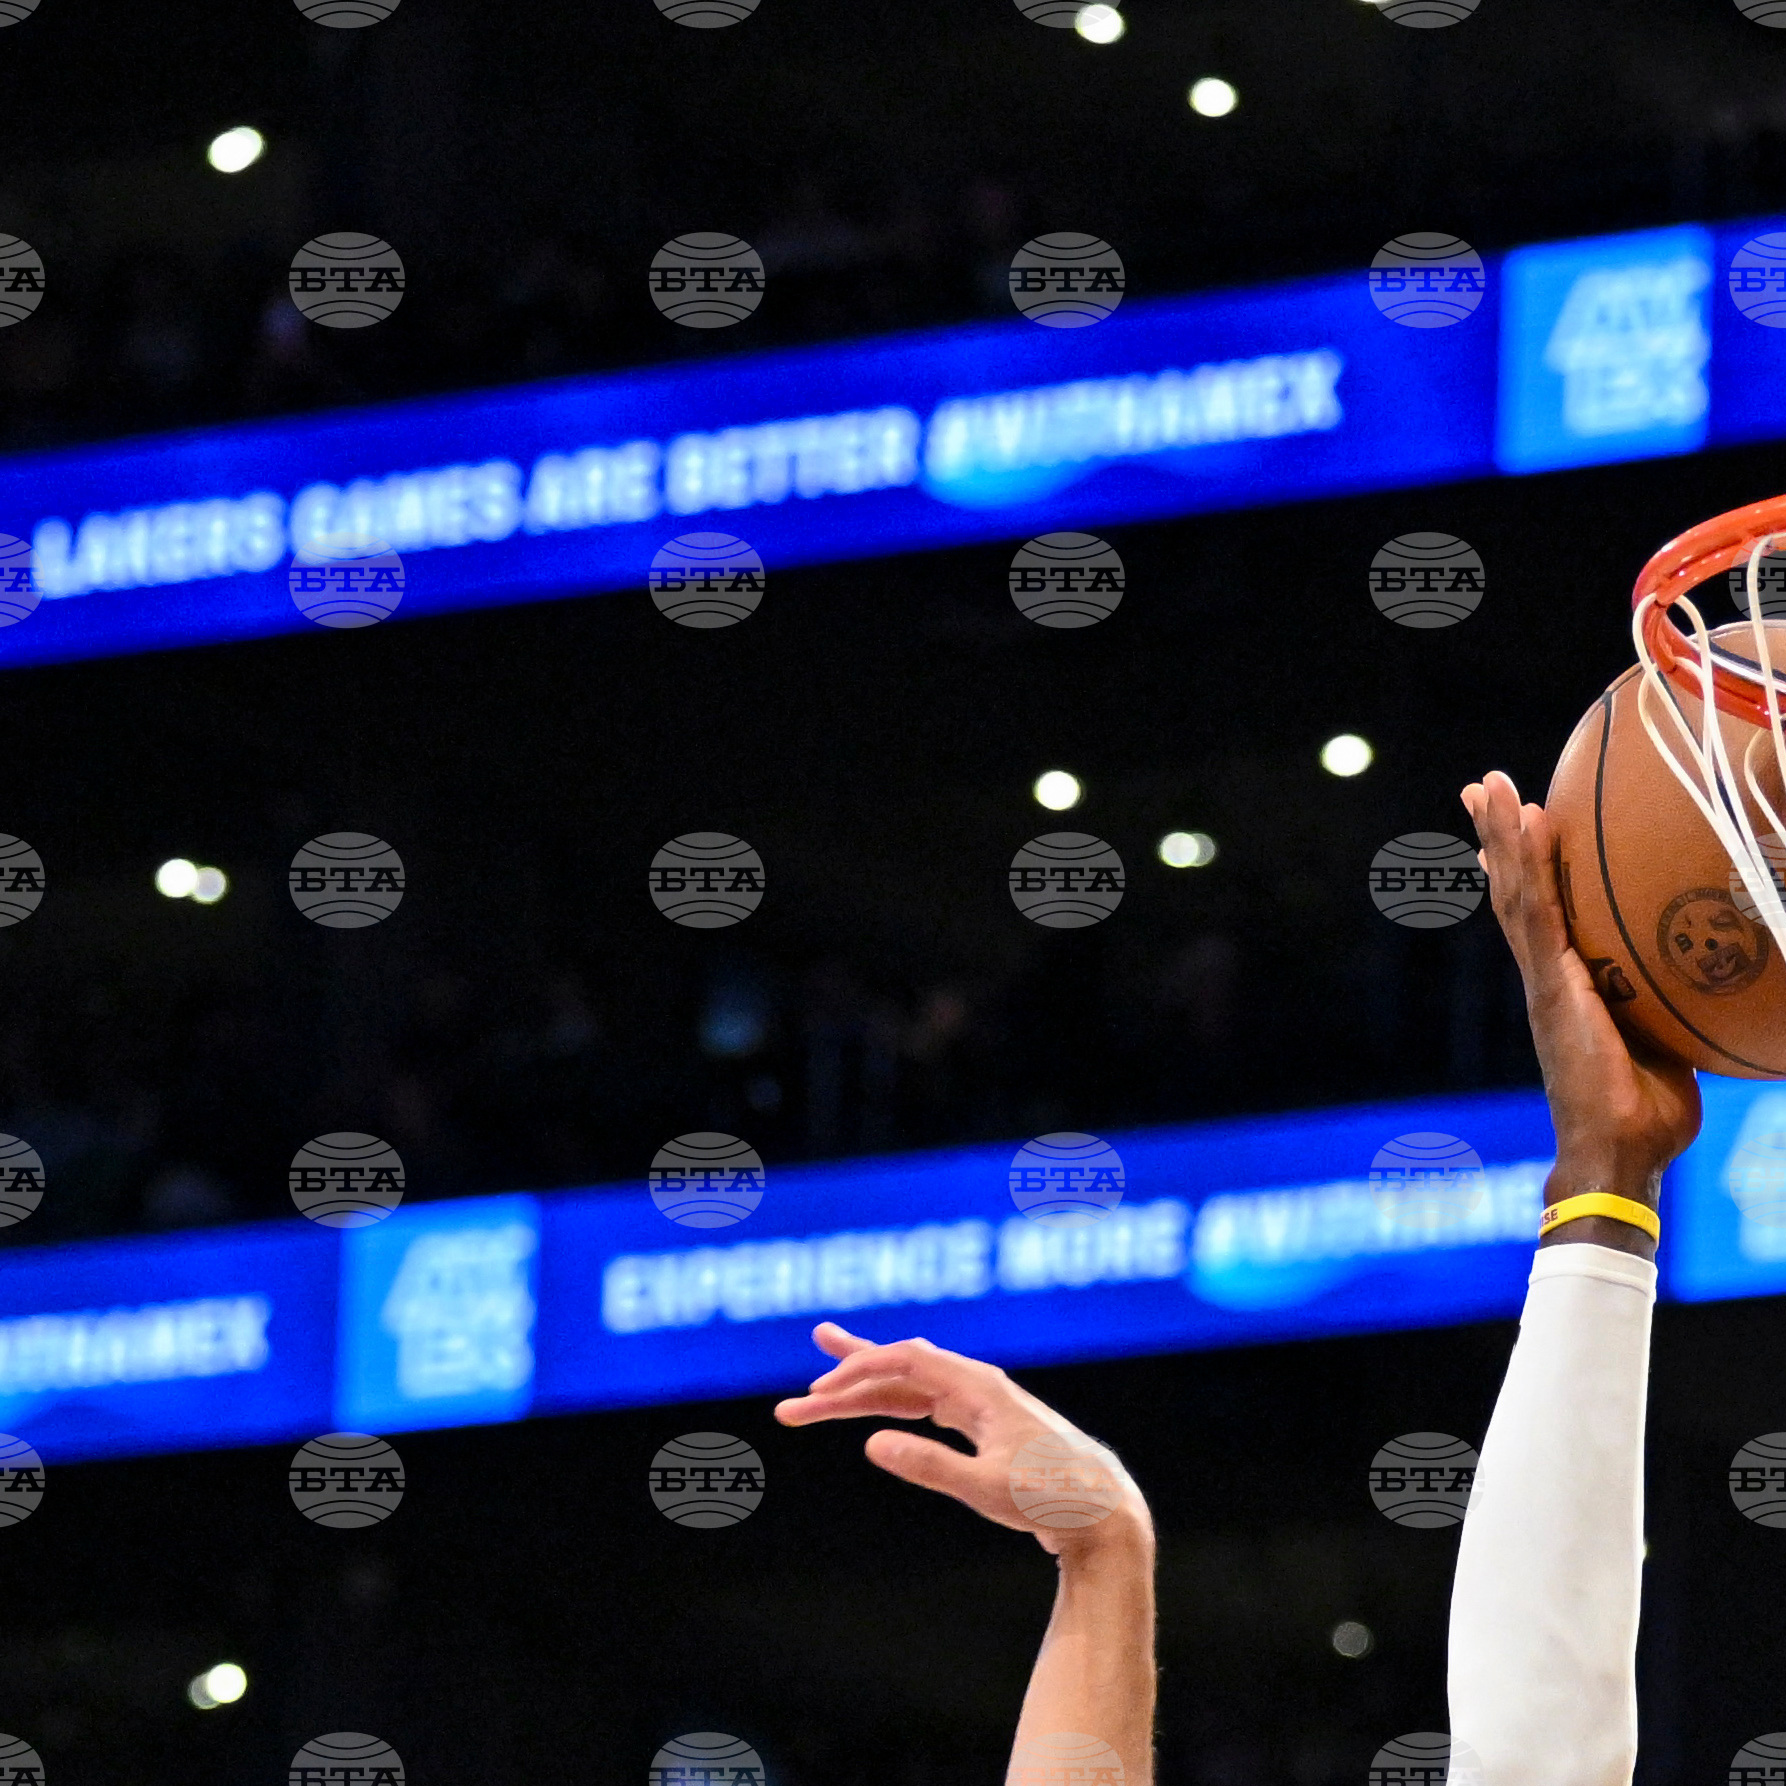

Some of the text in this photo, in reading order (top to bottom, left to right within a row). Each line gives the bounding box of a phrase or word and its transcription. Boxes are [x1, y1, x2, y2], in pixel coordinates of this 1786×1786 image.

[33, 491, 288, 599] LAKERS
[289, 459, 522, 566] GAMES
[524, 441, 662, 534] ARE
[664, 406, 922, 516] BETTER
[999, 1199, 1190, 1292] MORE
